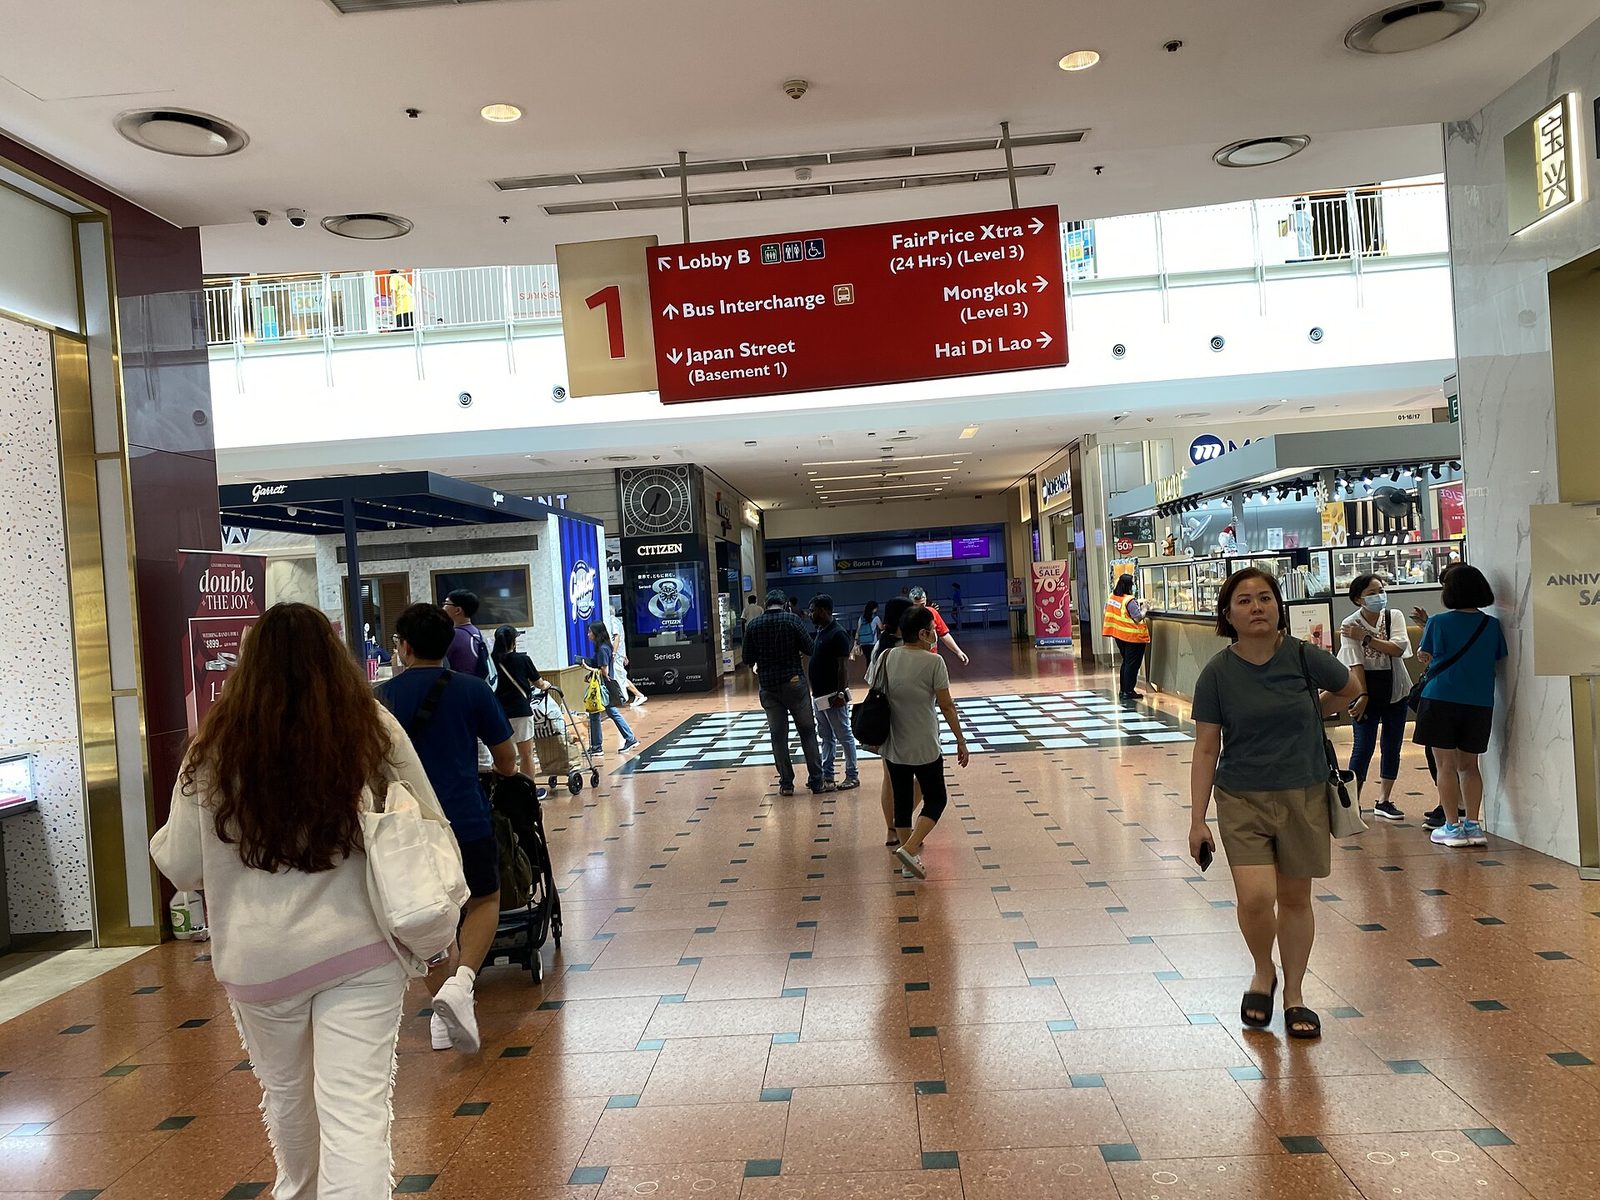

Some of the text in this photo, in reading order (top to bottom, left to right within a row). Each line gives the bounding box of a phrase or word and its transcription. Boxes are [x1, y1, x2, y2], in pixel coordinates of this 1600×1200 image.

[1542, 115, 1567, 207] 宝兴
[893, 224, 1024, 250] FairPrice Xtra
[678, 249, 750, 271] Lobby B
[889, 244, 1025, 274] (24 Hrs) (Level 3)
[519, 290, 560, 301] sunnyst
[944, 278, 1028, 301] Mongkok
[683, 295, 825, 318] Bus Interchange
[961, 301, 1029, 324] (Level 3)
[584, 285, 625, 359] 1
[686, 340, 796, 366] Japan Street
[936, 336, 1032, 359] Hai Di Lao
[688, 361, 788, 386] (Basement 1)
[1397, 413, 1420, 421] 01-16/17
[252, 484, 288, 503] Garrett
[637, 543, 682, 556] CITIZEN
[853, 559, 883, 568] Boon Lay
[199, 569, 254, 593] double
[1034, 577, 1064, 592] 70%
[206, 594, 250, 610] THE JOY
